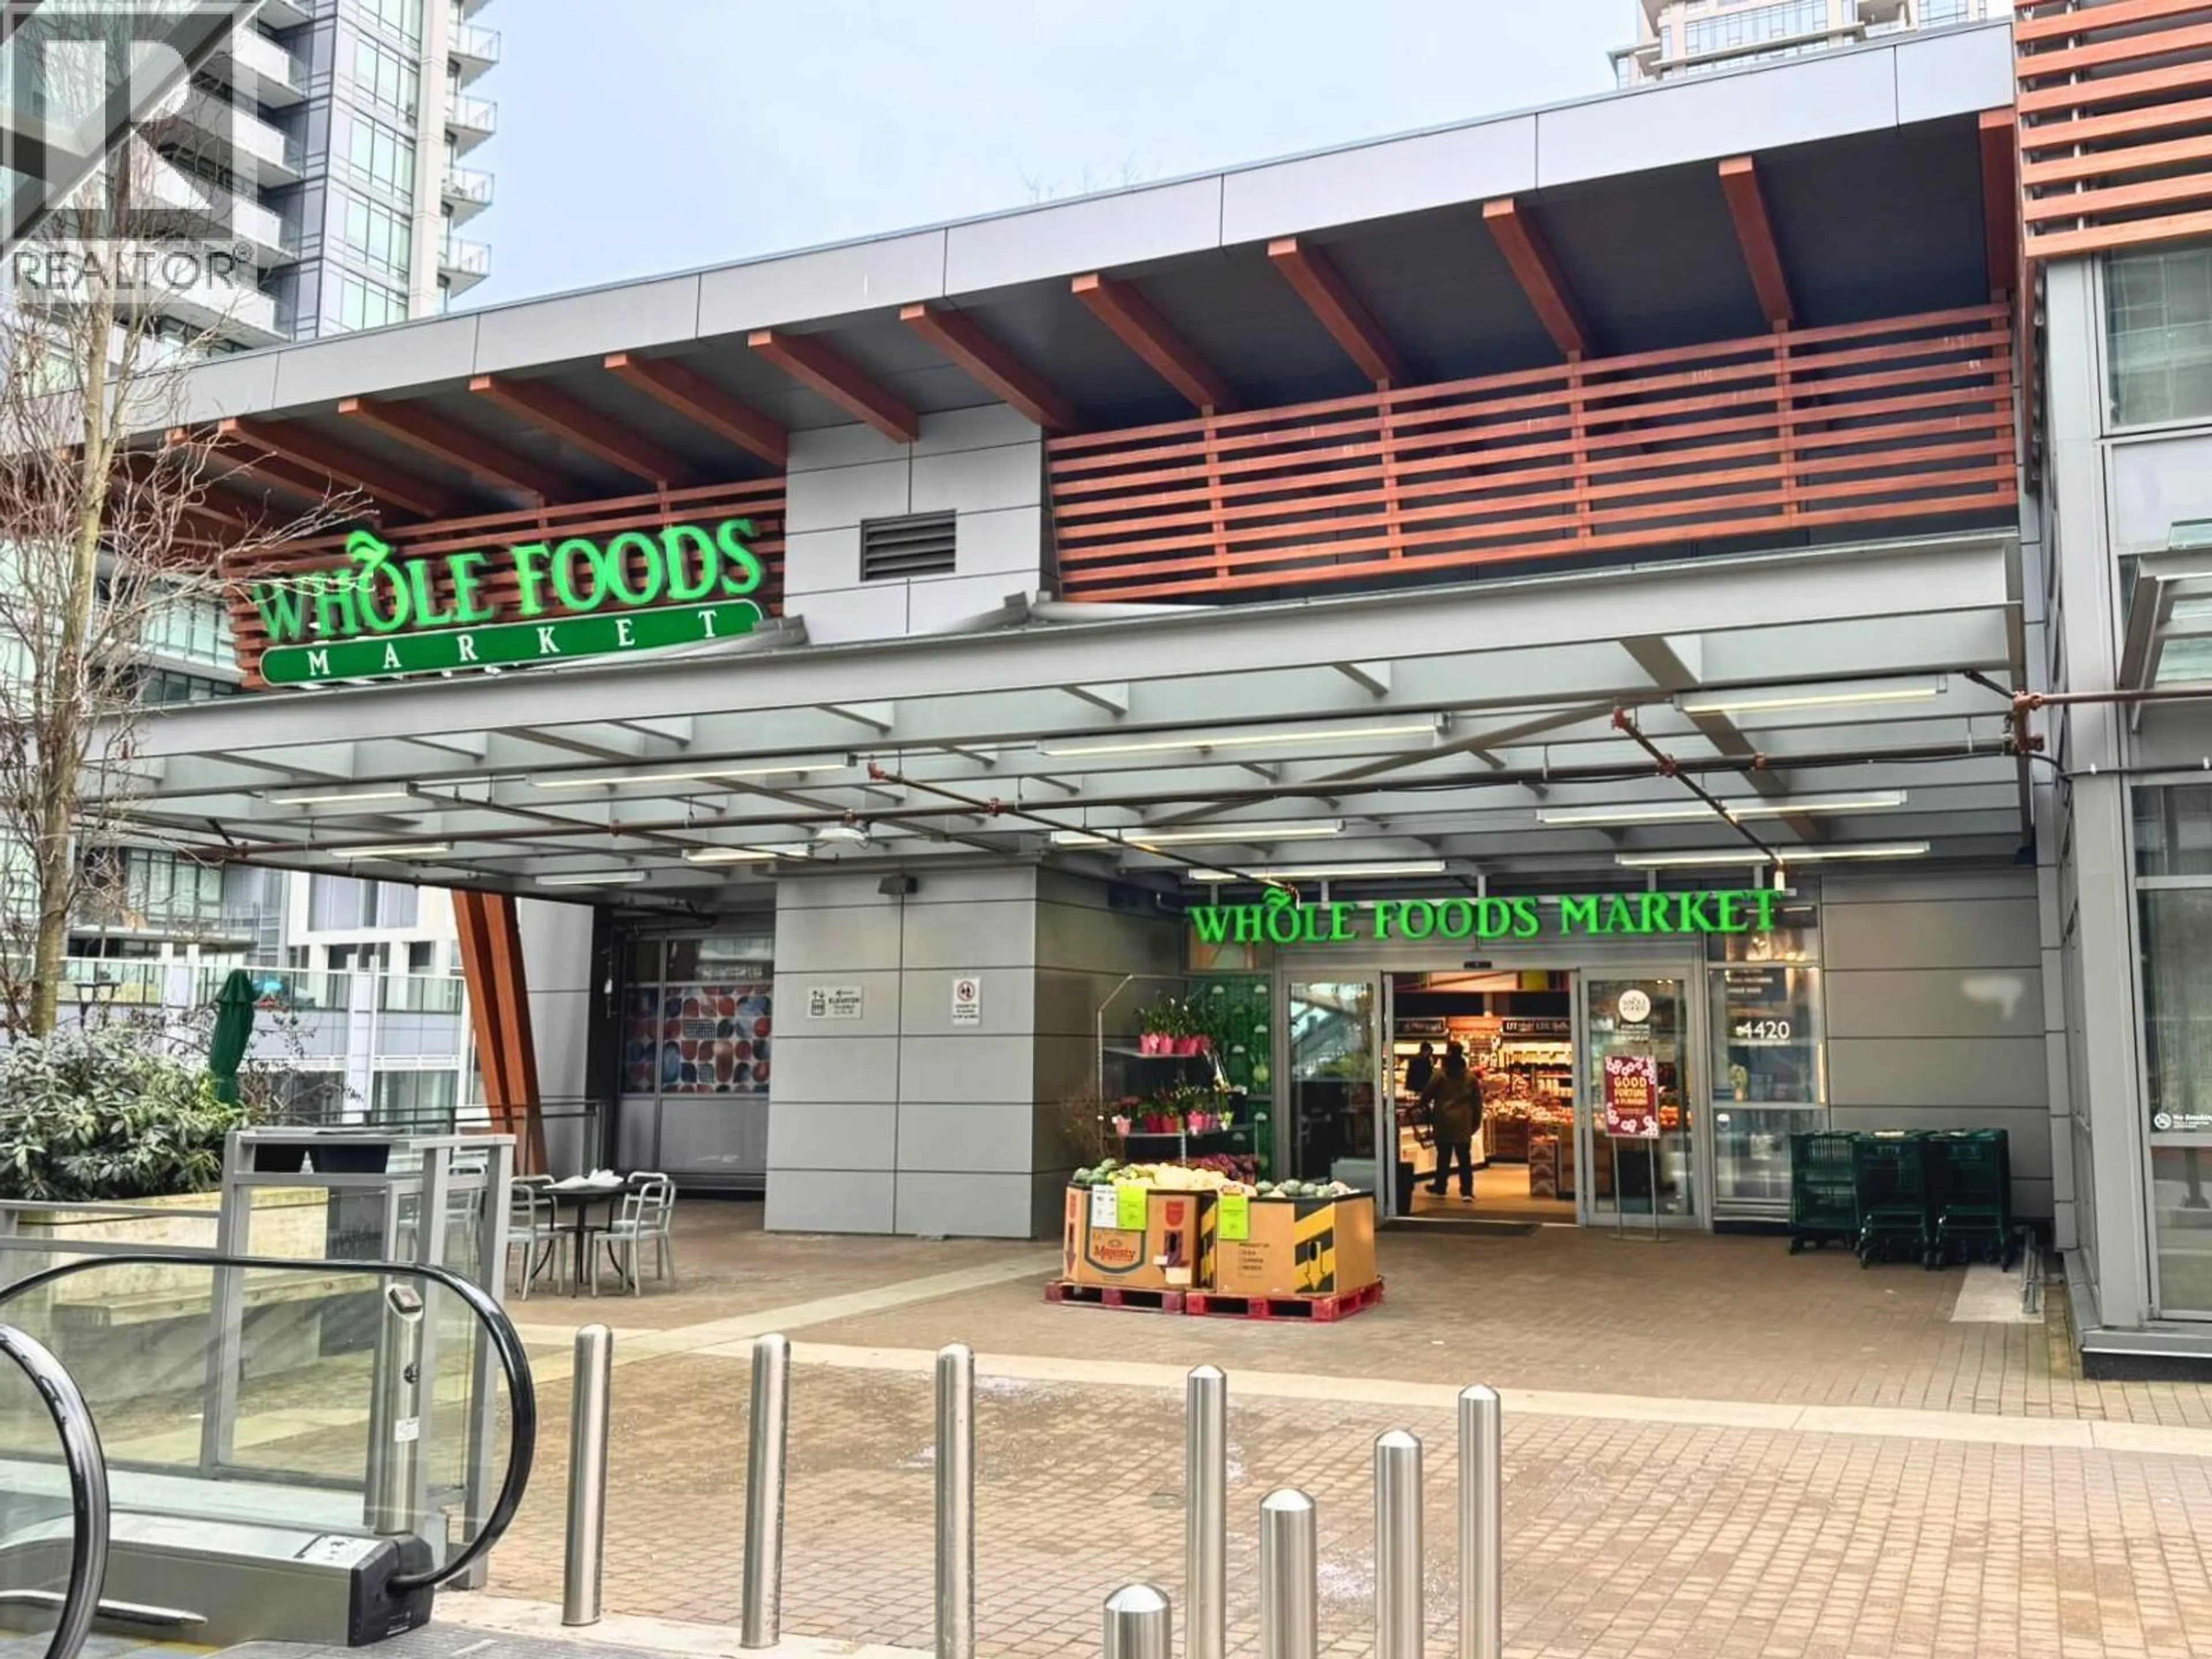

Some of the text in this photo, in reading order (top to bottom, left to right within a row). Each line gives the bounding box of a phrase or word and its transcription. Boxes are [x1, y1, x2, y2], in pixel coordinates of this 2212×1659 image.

[255, 519, 763, 641] WHOLE FOODS
[308, 611, 718, 676] MARKET
[1190, 889, 1780, 943] WHOLE FOODS MARKET
[1743, 1021, 1790, 1039] 4420
[1613, 1076, 1647, 1088] GOOD
